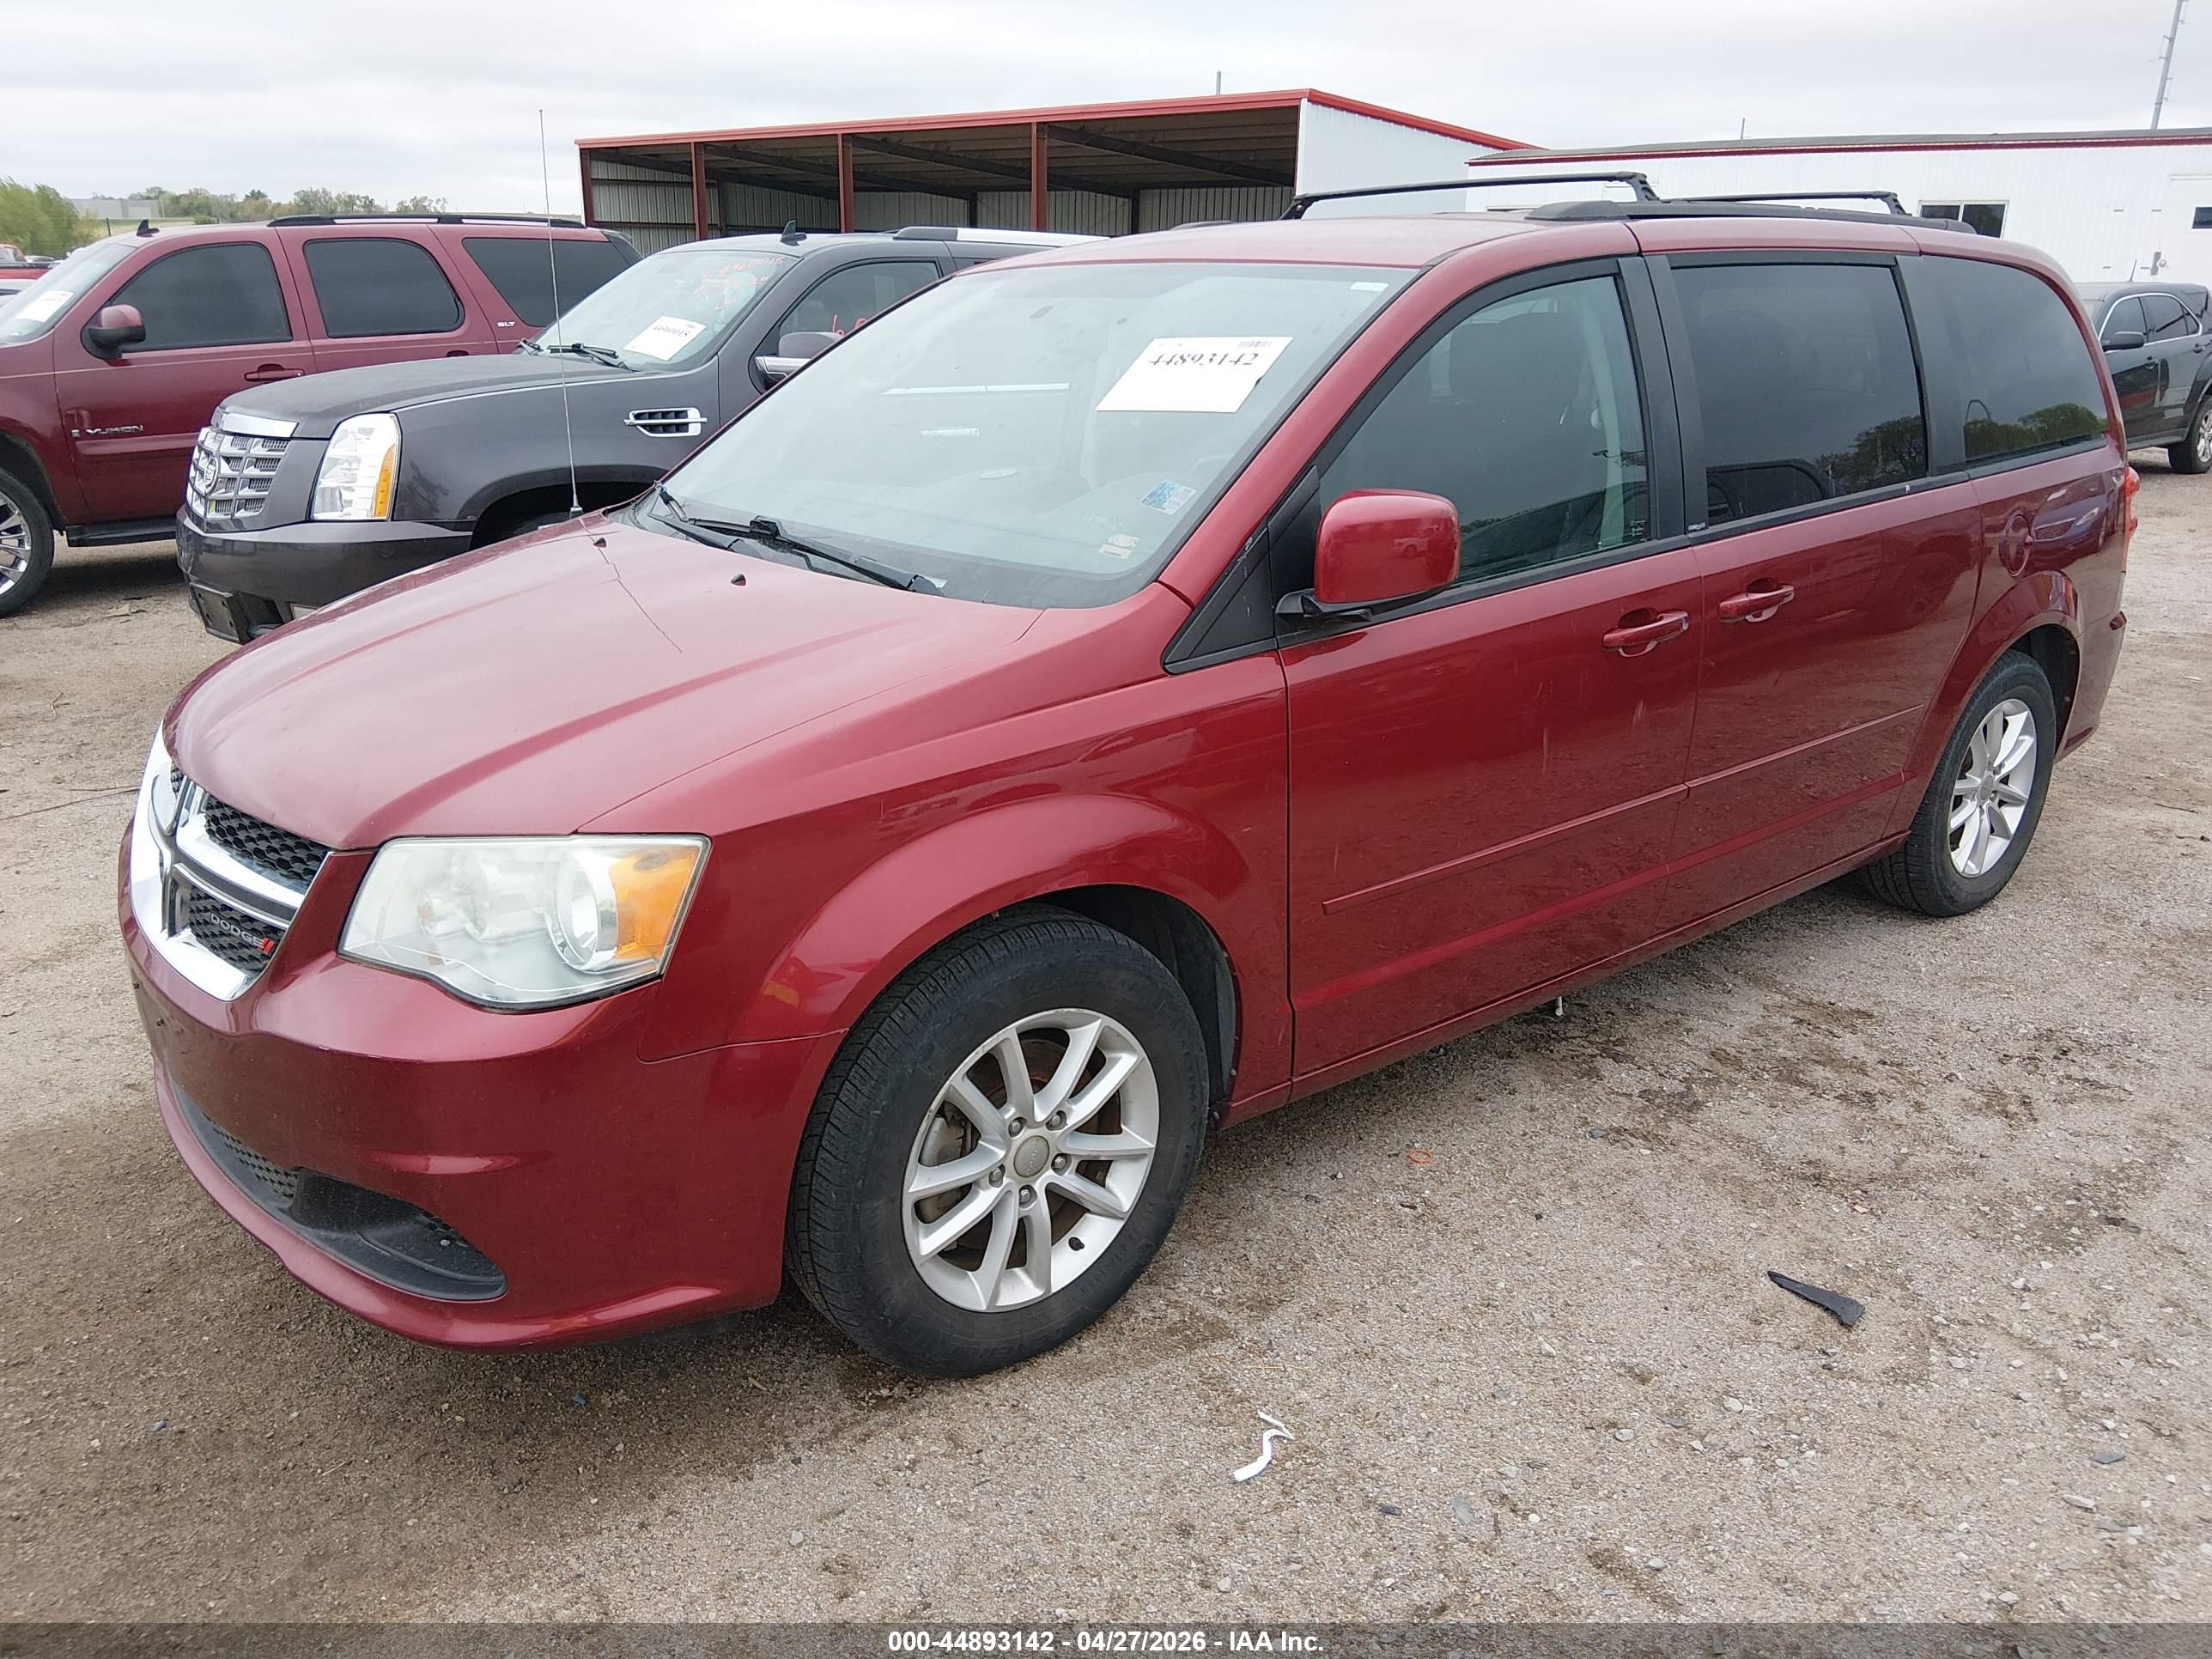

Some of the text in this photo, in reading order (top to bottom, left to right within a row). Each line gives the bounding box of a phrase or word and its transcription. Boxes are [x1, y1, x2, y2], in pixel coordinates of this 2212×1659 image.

[1149, 353, 1259, 366] 44893142
[86, 425, 143, 434] YUKON
[210, 913, 264, 949] DODGE
